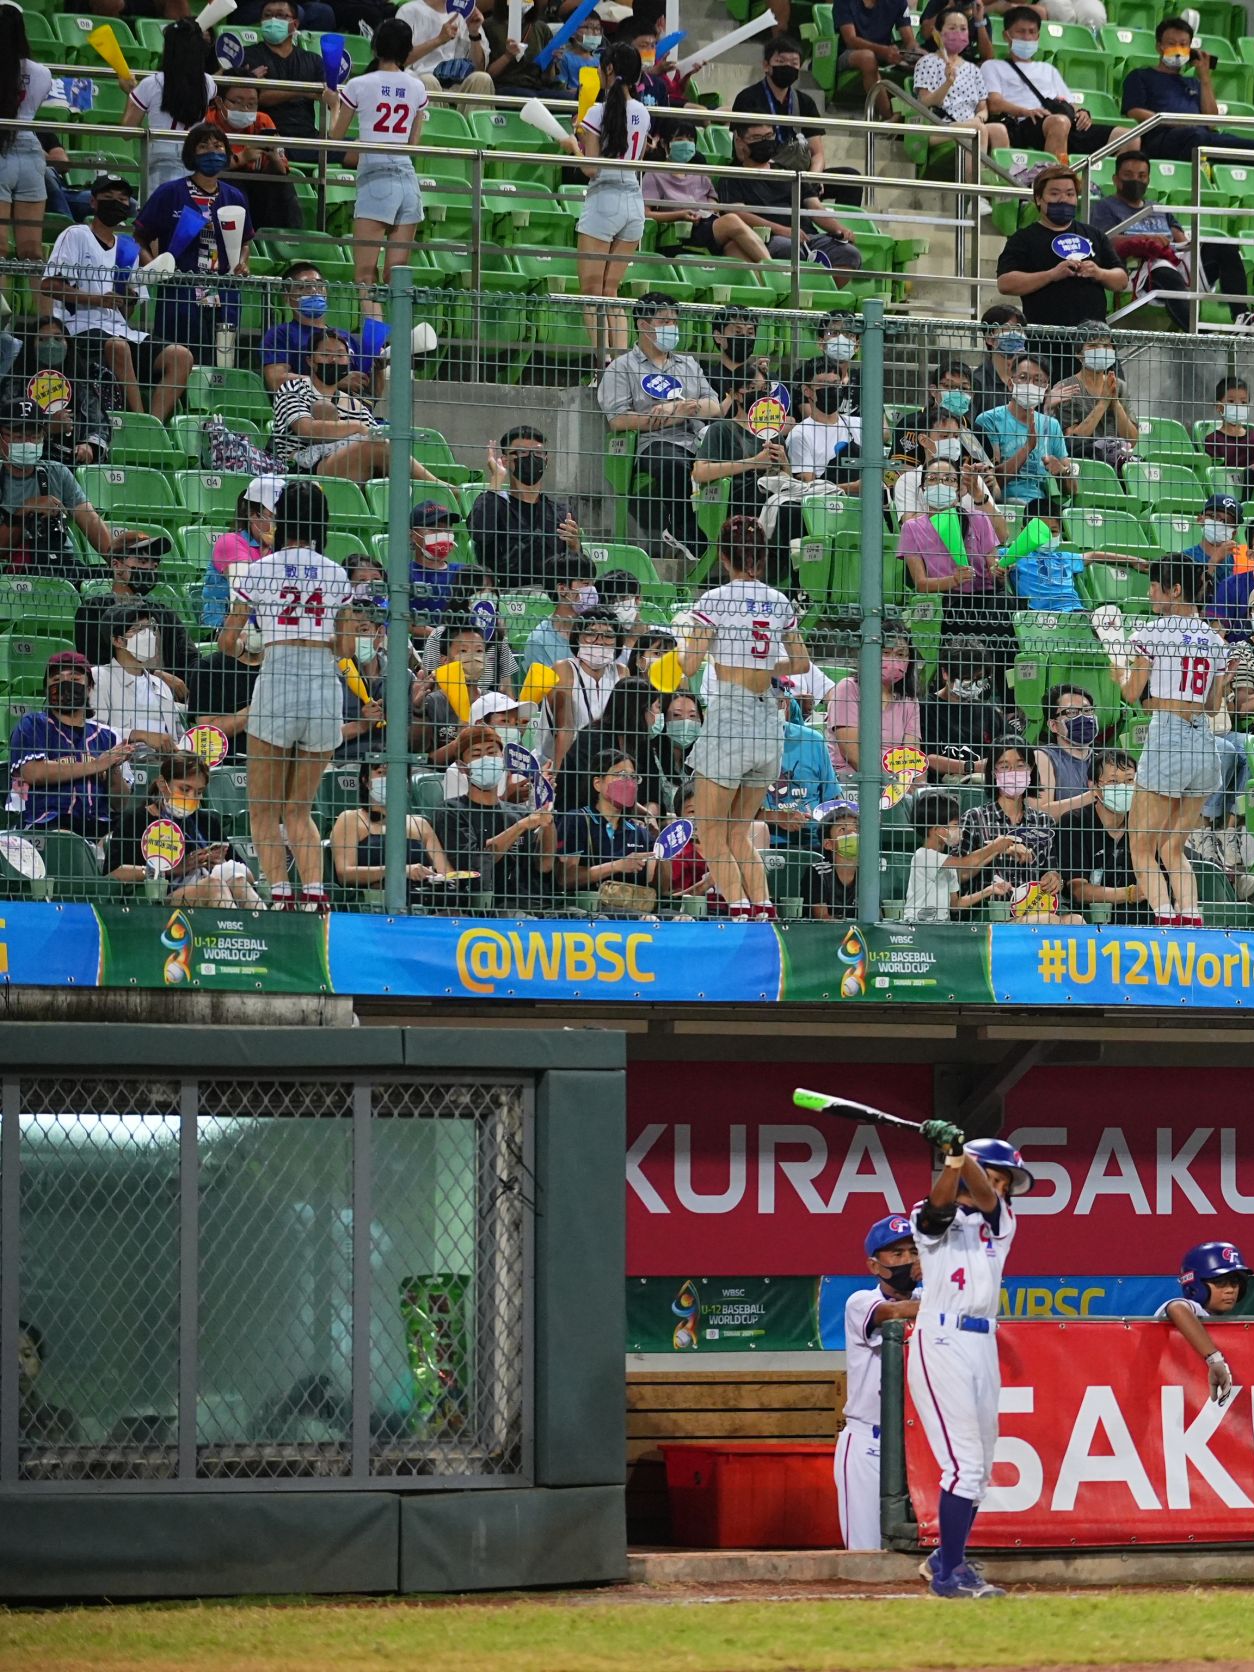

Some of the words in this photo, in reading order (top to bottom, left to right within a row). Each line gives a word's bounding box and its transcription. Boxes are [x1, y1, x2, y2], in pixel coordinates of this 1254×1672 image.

[373, 102, 410, 133] 22
[19, 402, 33, 416] F
[278, 586, 325, 626] 24
[751, 620, 769, 659] 5
[1179, 656, 1210, 695] 18
[217, 921, 243, 931] WBSC
[195, 937, 217, 949] U-12
[218, 938, 268, 951] BASEBALL
[890, 936, 913, 944] WBSC
[203, 949, 240, 961] WORLD
[240, 950, 260, 961] CUP
[456, 928, 655, 993] @WBSC
[869, 952, 890, 962] U-12
[891, 952, 936, 963] BASEBALL
[878, 963, 911, 973] WORLD
[912, 963, 930, 973] CUP
[950, 1267, 966, 1290] 4
[722, 1289, 745, 1297] WBSC
[701, 1305, 721, 1314] U-12
[722, 1304, 765, 1314] BASEBALL
[709, 1315, 741, 1324] WORLD
[741, 1315, 758, 1324] CUP
